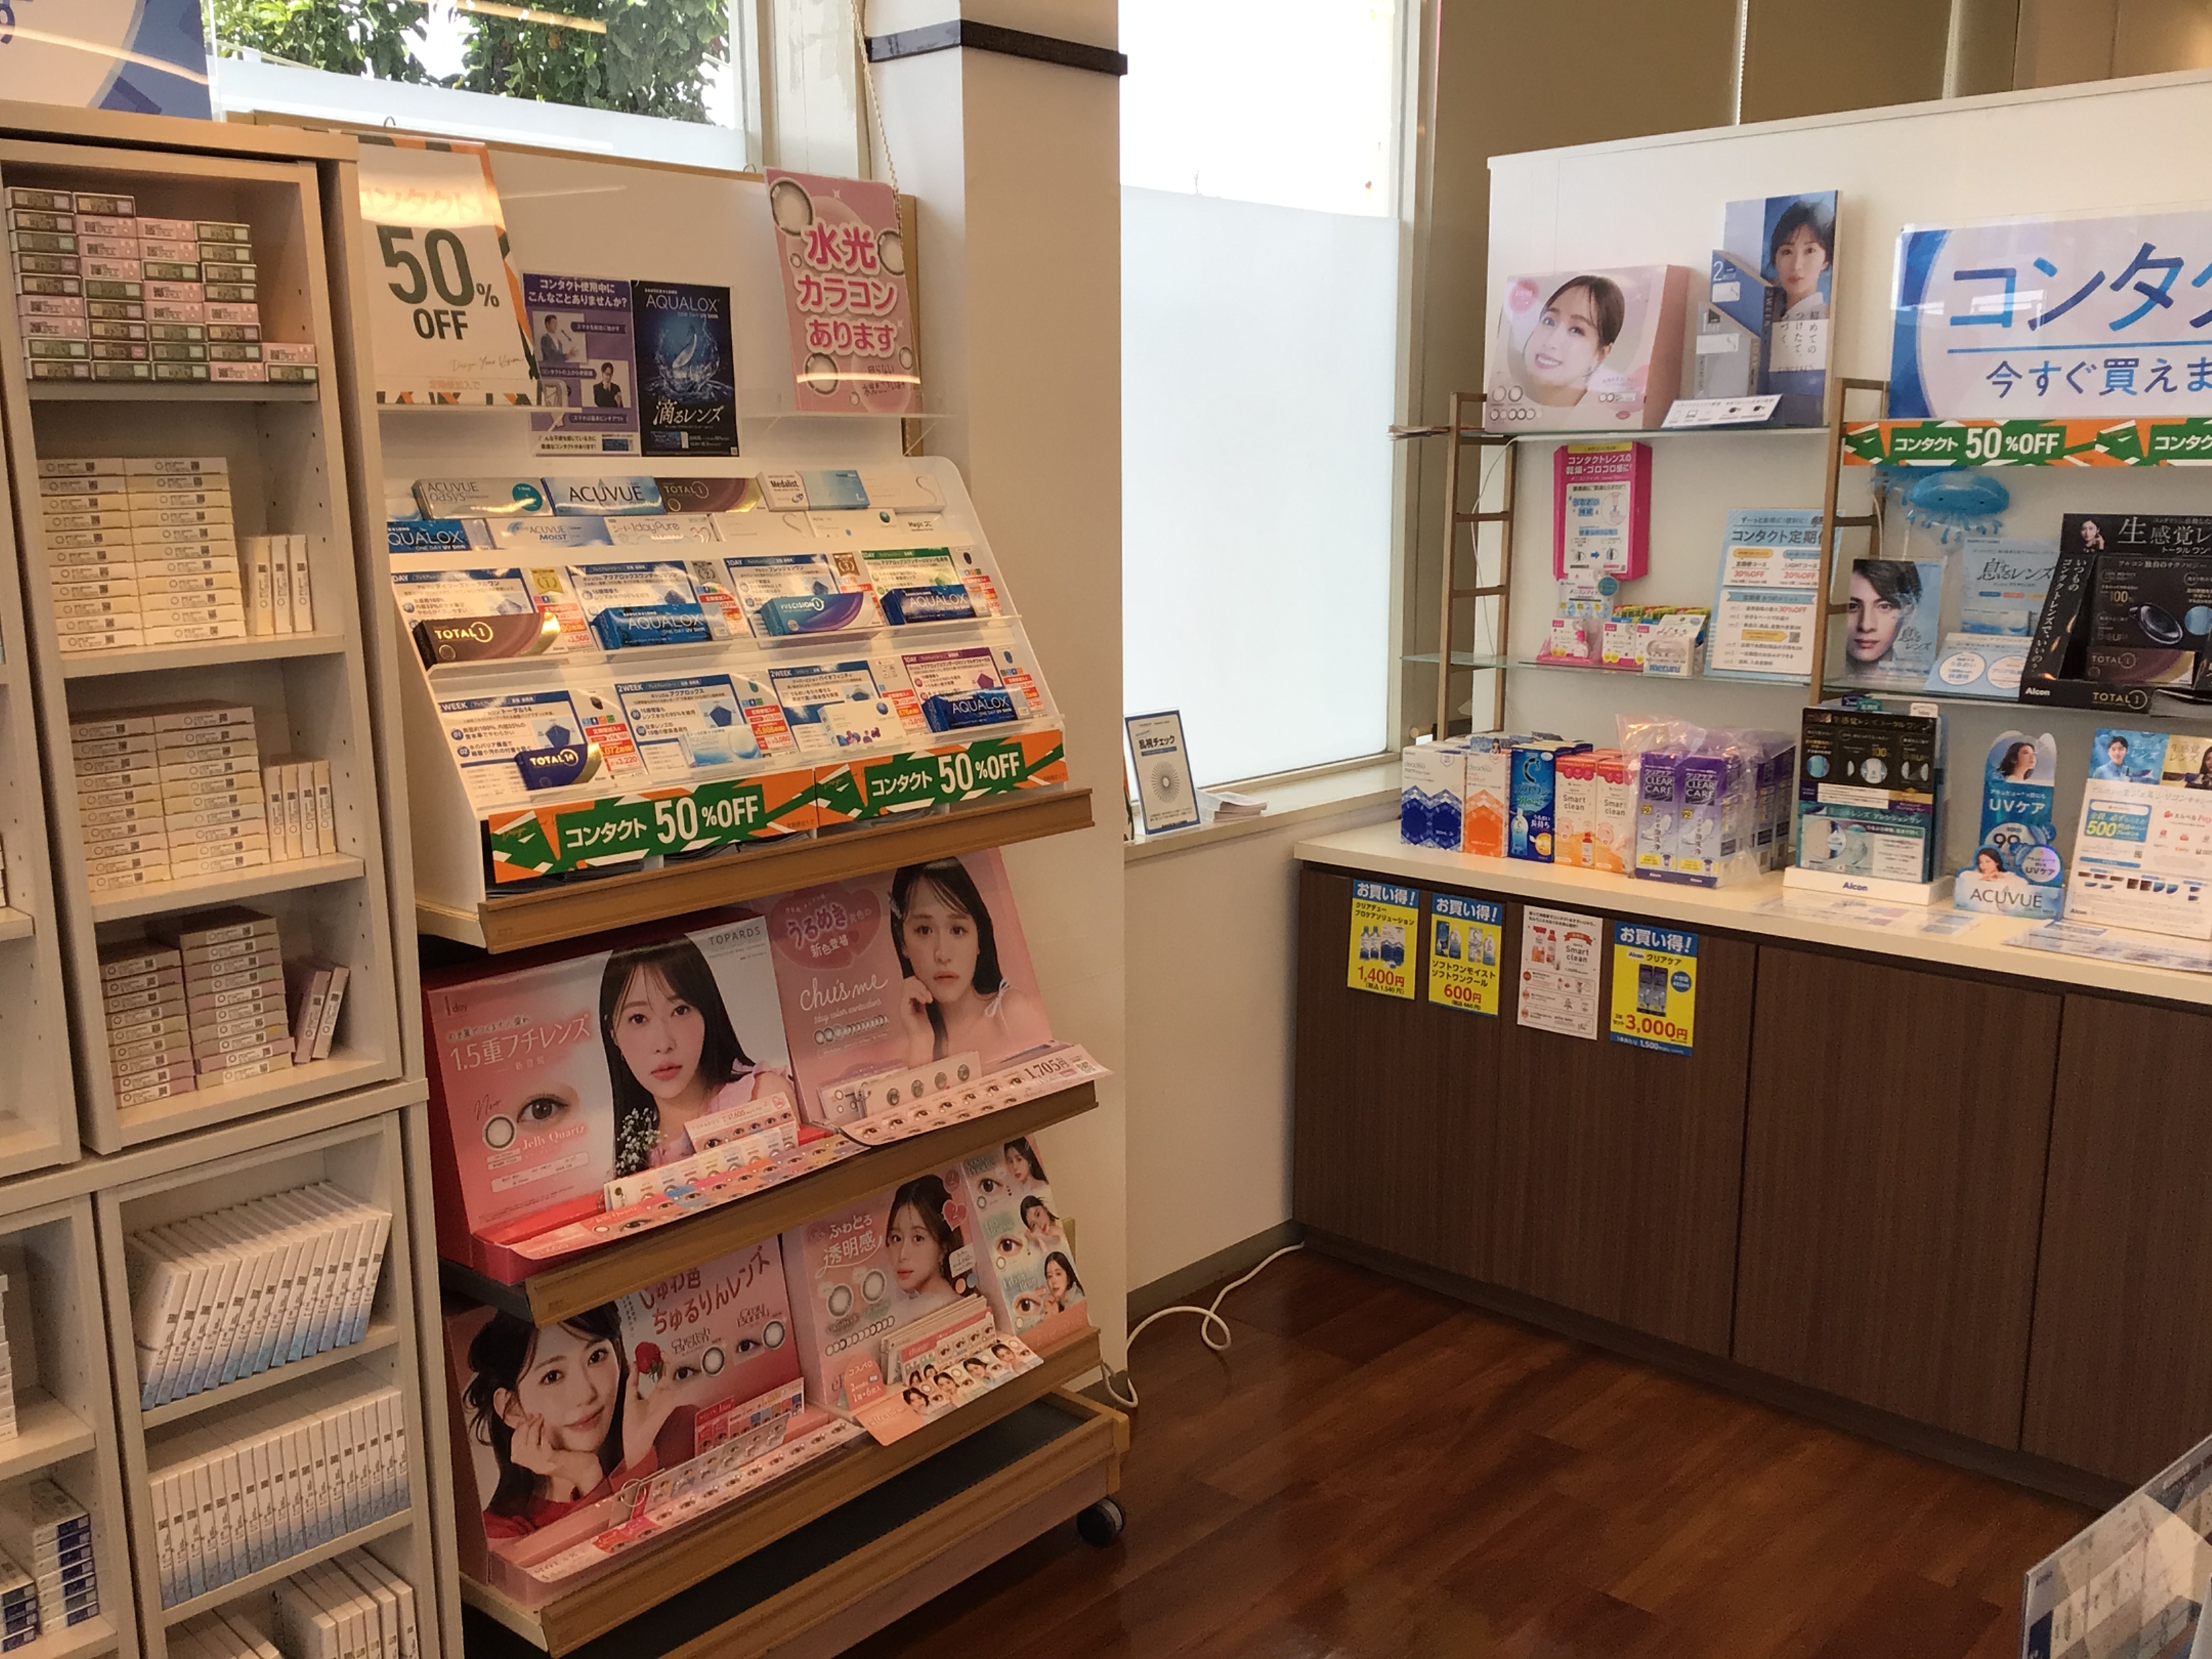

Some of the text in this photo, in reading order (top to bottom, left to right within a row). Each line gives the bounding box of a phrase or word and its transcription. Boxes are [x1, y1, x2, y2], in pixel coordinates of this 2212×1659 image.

[807, 222, 877, 269] 水光
[539, 279, 615, 293] コンタクト使用中に
[797, 274, 894, 310] カラコン
[528, 291, 628, 308] こんなことありませんか?
[645, 294, 719, 312] AQUALOX
[413, 308, 468, 340] OFF
[1807, 310, 1820, 354] 初めての
[809, 319, 894, 352] あります
[1986, 356, 2212, 398] 今すぐ買えま
[653, 398, 724, 426] 滴るレンズ
[1894, 436, 1959, 453] コンタクト
[1568, 454, 1632, 465] コンタクトレンズの
[428, 481, 479, 492] ACUVUE
[770, 480, 799, 489] Medalist
[430, 491, 467, 502] oasys
[569, 485, 645, 502] ACUVUE
[530, 526, 566, 534] ACUVUE
[2117, 516, 2212, 546] 生感覚レ
[2068, 558, 2087, 592] いつもの
[909, 594, 968, 608] AQUALOX
[628, 613, 704, 630] AQUALOX
[770, 670, 792, 678] 2WEEK
[1649, 665, 1681, 674] meruru
[617, 684, 644, 693] 2WEEK
[669, 689, 705, 697] アクアロックス
[2025, 687, 2051, 697] Alcon
[952, 696, 1009, 714] AQUALOX
[1139, 735, 1176, 750] 乱視チェック
[871, 769, 934, 798] コンタクト
[1645, 776, 1673, 785] CLEAR
[1686, 779, 1715, 789] CLEAR
[1645, 785, 1673, 794] CARE
[1685, 789, 1715, 798] CARE
[1563, 794, 1586, 804] Smart
[1564, 802, 1585, 811] clean
[1988, 798, 2046, 815] UVケア
[1605, 807, 1626, 816] clean
[565, 817, 648, 848] コンタクト
[1531, 819, 1551, 829] 長持ち
[2086, 821, 2118, 838] 500
[2025, 866, 2056, 876] UVケア
[1357, 882, 1416, 906] お買い得!
[1843, 882, 1868, 891] Alcon
[1355, 901, 1388, 912] クリアデュー
[1969, 887, 2043, 909] ACUVUE
[1355, 909, 1415, 926] プロケアソリューション
[1435, 898, 1498, 922] お買い得!
[786, 903, 847, 950] うるめき
[708, 926, 761, 946] TOPARDS
[1620, 926, 1693, 953] お買い得!
[809, 934, 850, 959] 新色登場
[1565, 945, 1590, 956] Smart
[1566, 954, 1589, 964] clean
[1646, 954, 1682, 966] クリアケア
[1357, 965, 1406, 988] 1,400円
[1431, 960, 1496, 979] ソフトワンモイスト
[1431, 969, 1489, 988] ソフトワンクール
[1443, 983, 1482, 1004] 600円
[1626, 1014, 1688, 1041] 3,000円
[449, 1013, 591, 1071] 1.5重フチレンズ
[515, 1055, 546, 1071] 新登場
[523, 1125, 586, 1150] Jelly Quartz
[830, 1214, 874, 1240] ふわとろ
[823, 1230, 877, 1265] 透明感
[652, 1246, 771, 1335] ちゅるりんレンズ
